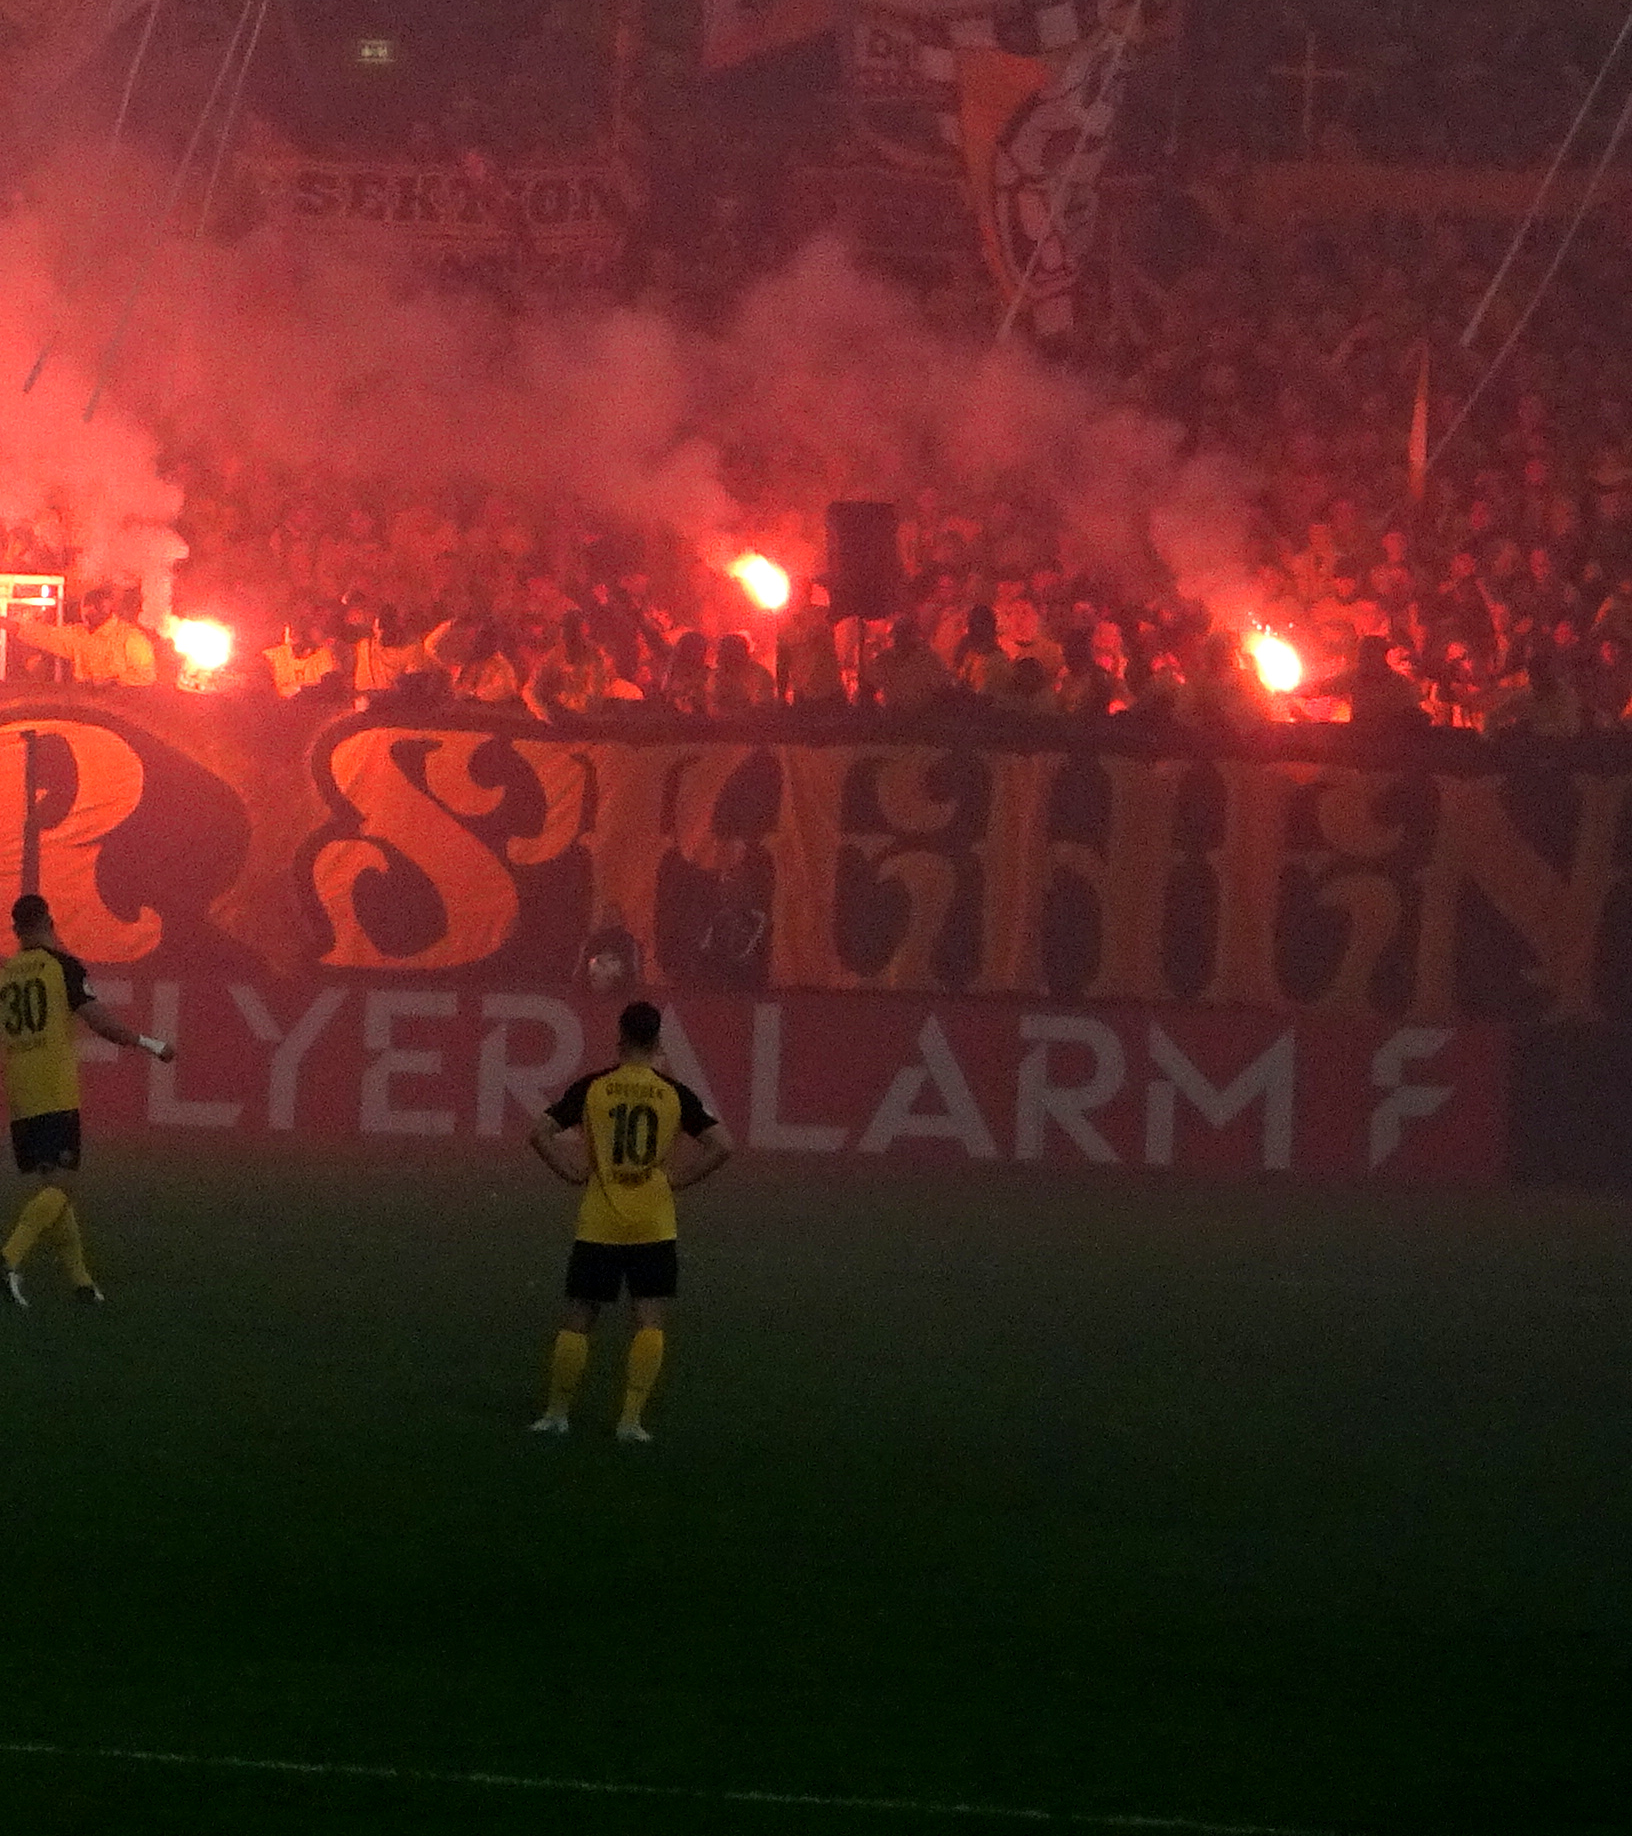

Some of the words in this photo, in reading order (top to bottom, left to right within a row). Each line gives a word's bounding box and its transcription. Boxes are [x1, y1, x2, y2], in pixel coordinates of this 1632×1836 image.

[293, 170, 626, 225] SEKTON
[310, 725, 1629, 1024] STEHEN
[0, 977, 47, 1035] 30
[608, 1103, 658, 1165] 10
